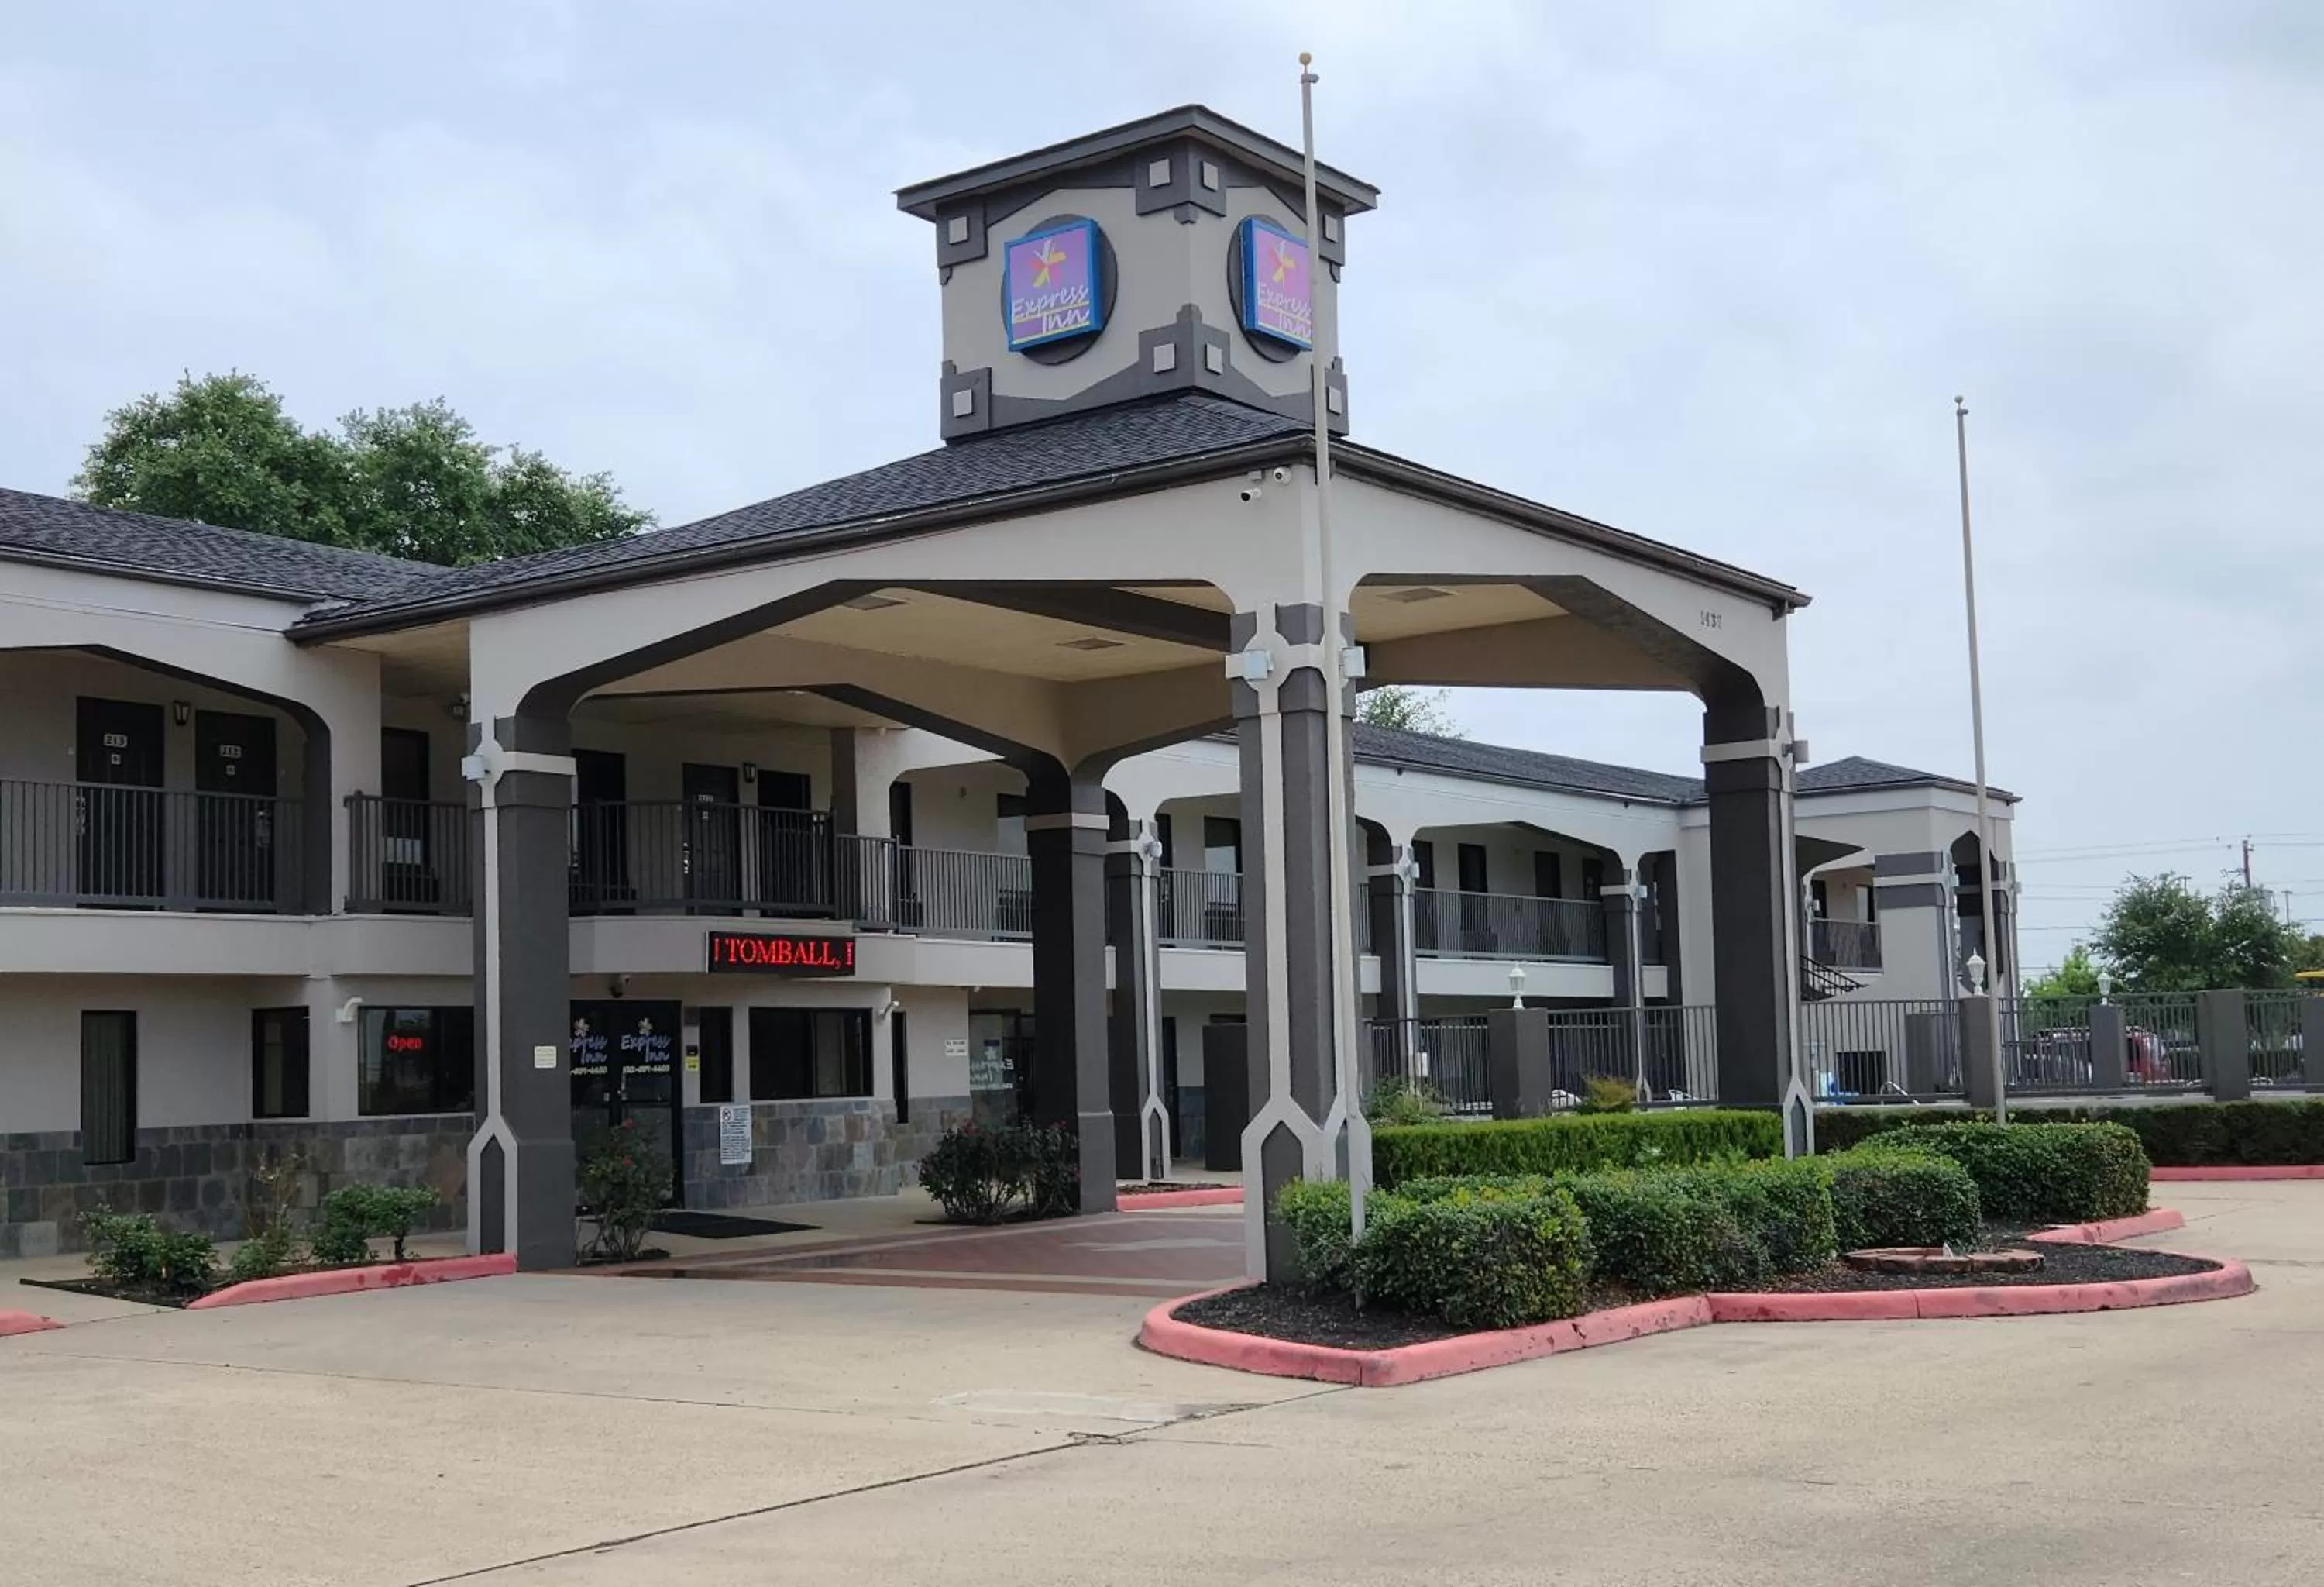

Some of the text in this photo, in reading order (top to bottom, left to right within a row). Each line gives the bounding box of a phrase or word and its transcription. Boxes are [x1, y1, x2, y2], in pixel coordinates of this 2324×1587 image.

[1012, 285, 1089, 322] Express
[1258, 281, 1312, 322] Express
[1042, 308, 1089, 334] Inn
[1278, 309, 1312, 337] Inn
[726, 936, 841, 969] TOMBALL,
[389, 1034, 422, 1052] Open
[621, 1034, 672, 1052] Express
